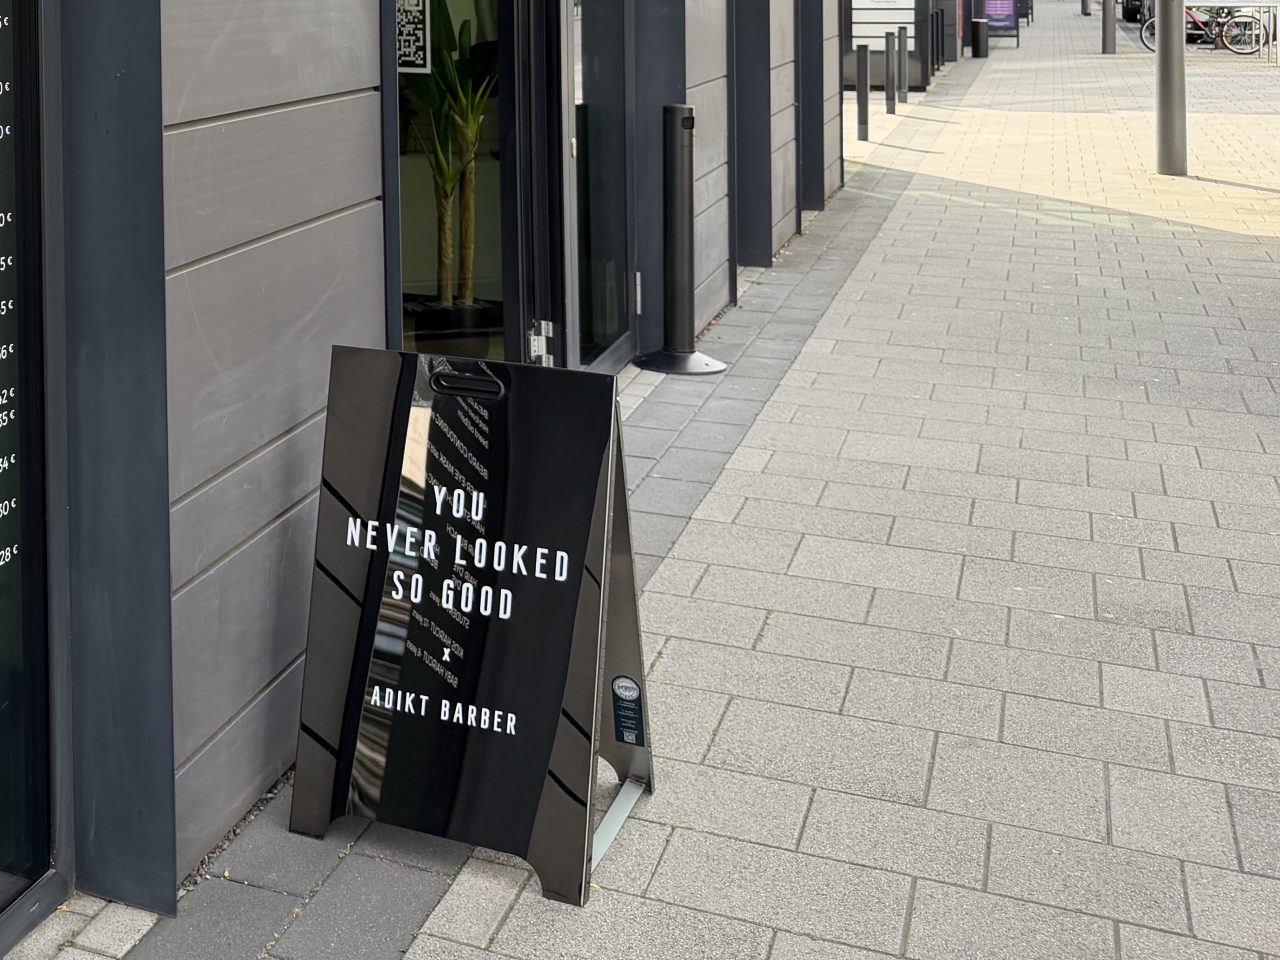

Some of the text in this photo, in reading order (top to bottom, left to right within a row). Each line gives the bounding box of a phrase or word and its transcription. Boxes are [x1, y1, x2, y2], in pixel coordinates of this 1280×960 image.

[433, 485, 485, 521] YOU
[346, 516, 437, 560] NEVER
[454, 534, 569, 582] LOOKED
[391, 570, 513, 620] SO GOOD
[370, 685, 517, 735] ADIKT BARBER
